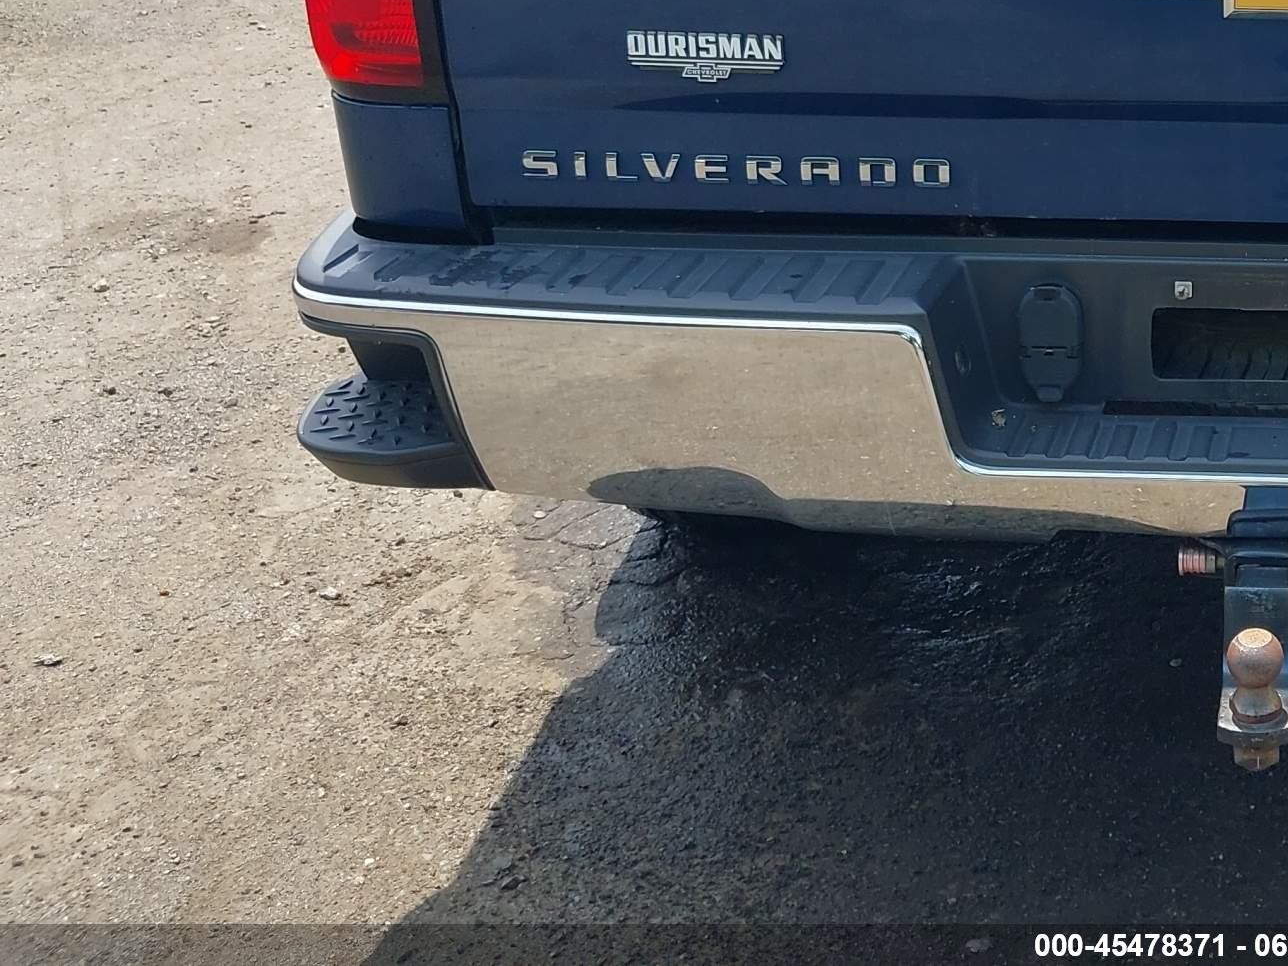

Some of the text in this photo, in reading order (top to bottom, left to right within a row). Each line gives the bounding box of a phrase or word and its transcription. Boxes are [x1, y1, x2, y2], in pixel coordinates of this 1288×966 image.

[626, 30, 784, 61] OURISMAN
[686, 68, 728, 77] CHEVROLET
[521, 149, 951, 187] SILVERADO
